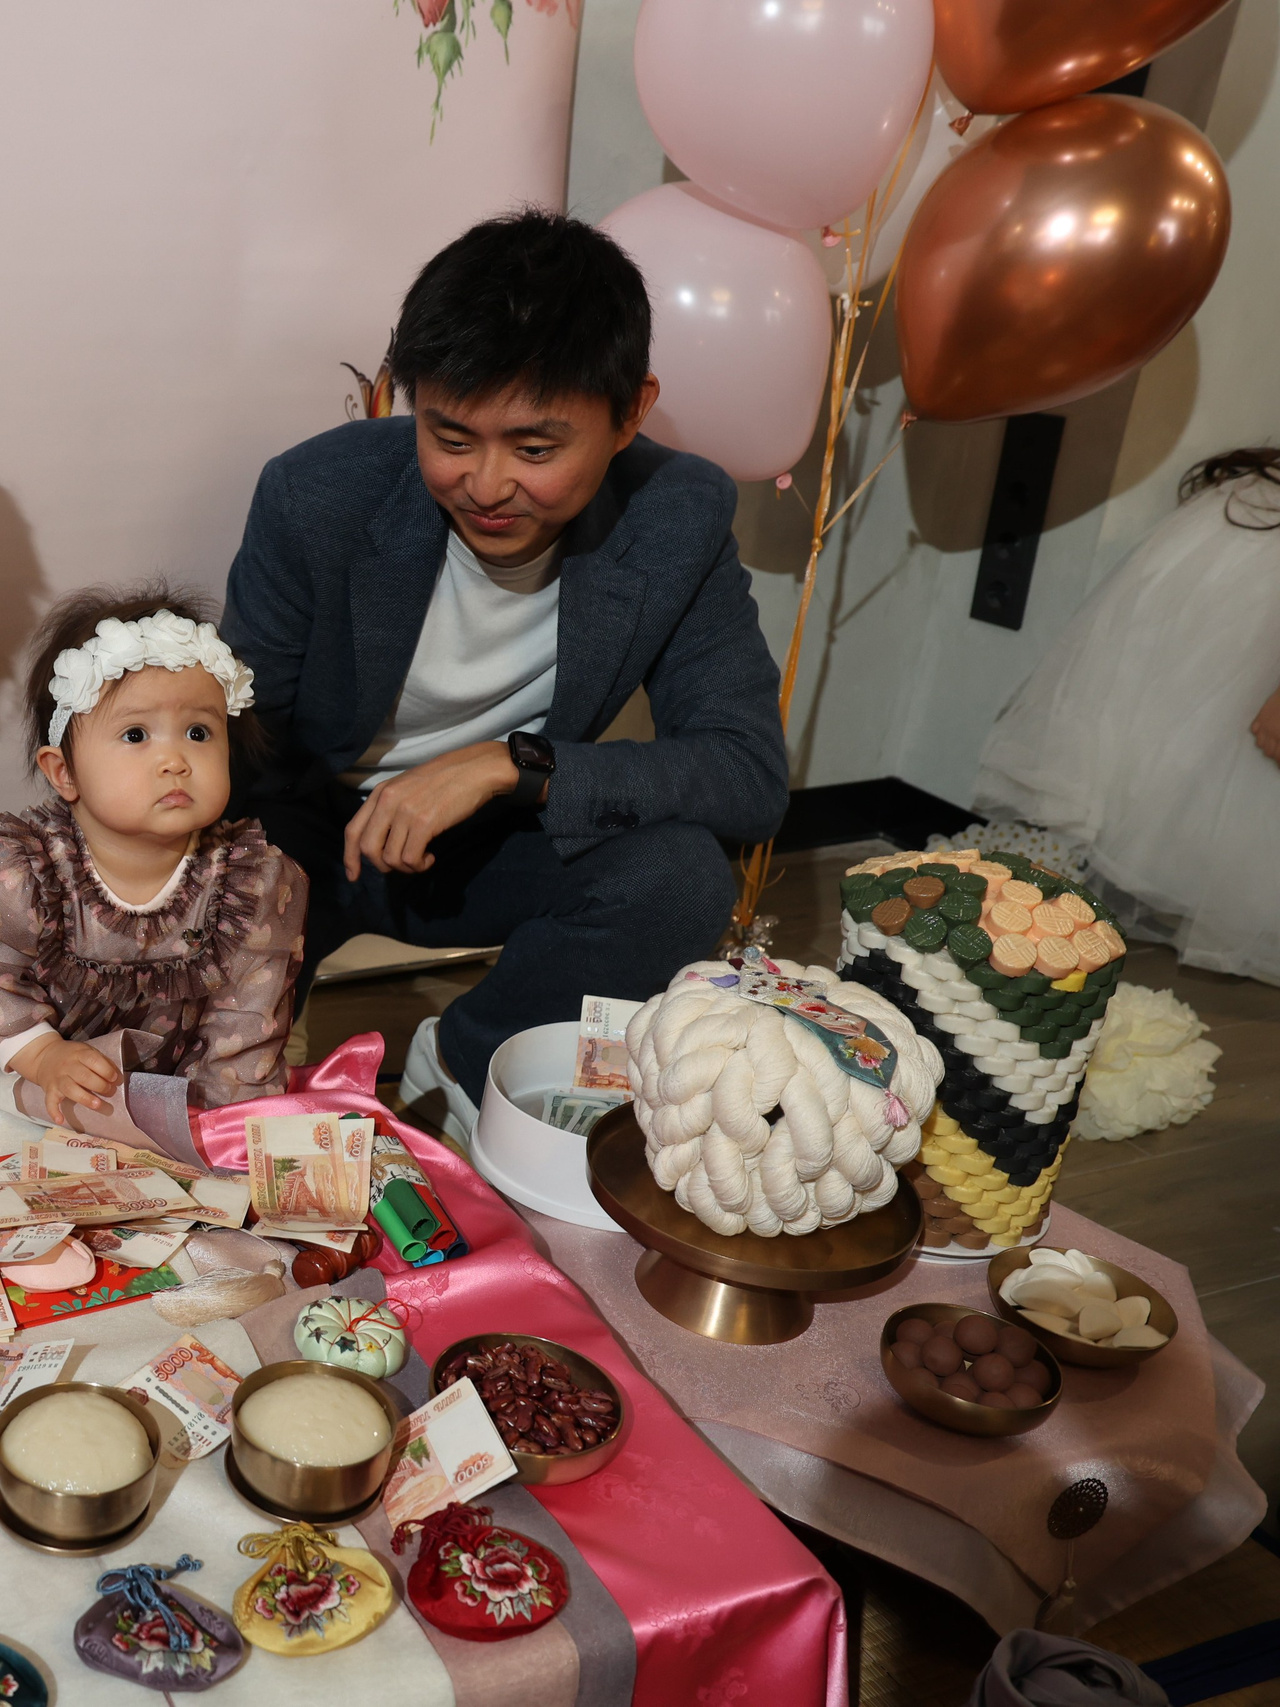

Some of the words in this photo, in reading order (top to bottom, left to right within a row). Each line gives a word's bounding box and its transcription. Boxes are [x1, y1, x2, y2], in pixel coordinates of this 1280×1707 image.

[317, 1122, 331, 1150] 5000
[353, 1129, 364, 1159] 5000
[116, 1197, 167, 1212] 5000
[153, 1347, 193, 1382] 5000
[454, 1454, 495, 1484] 5000
